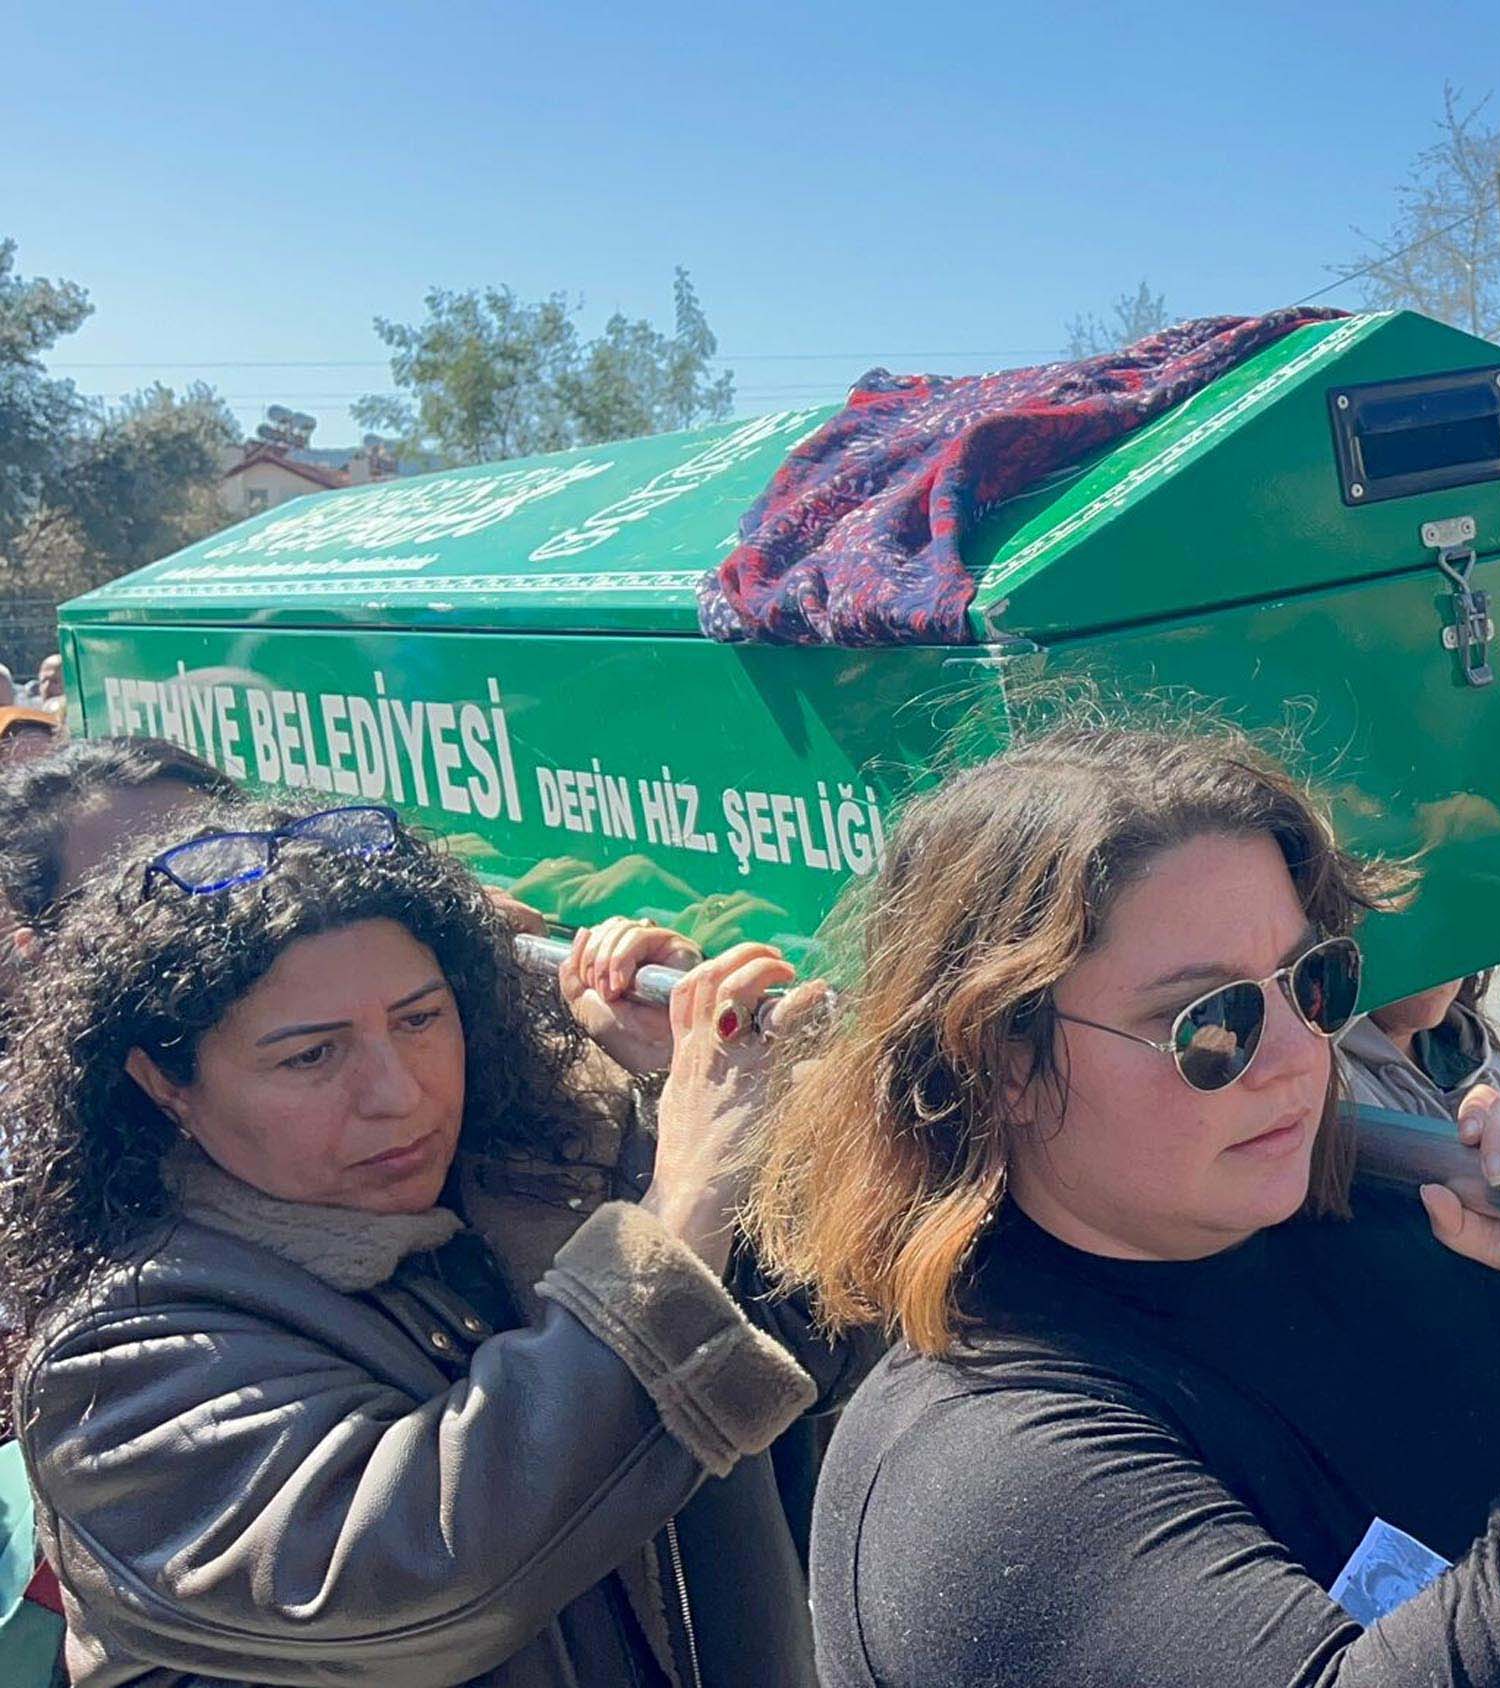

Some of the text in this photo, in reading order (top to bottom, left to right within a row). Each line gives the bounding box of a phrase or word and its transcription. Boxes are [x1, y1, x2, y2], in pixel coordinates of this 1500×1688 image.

[105, 660, 886, 876] FETHİYE BELEDİYESİ DEFİN HİZ. ŞEFLİĞİ
